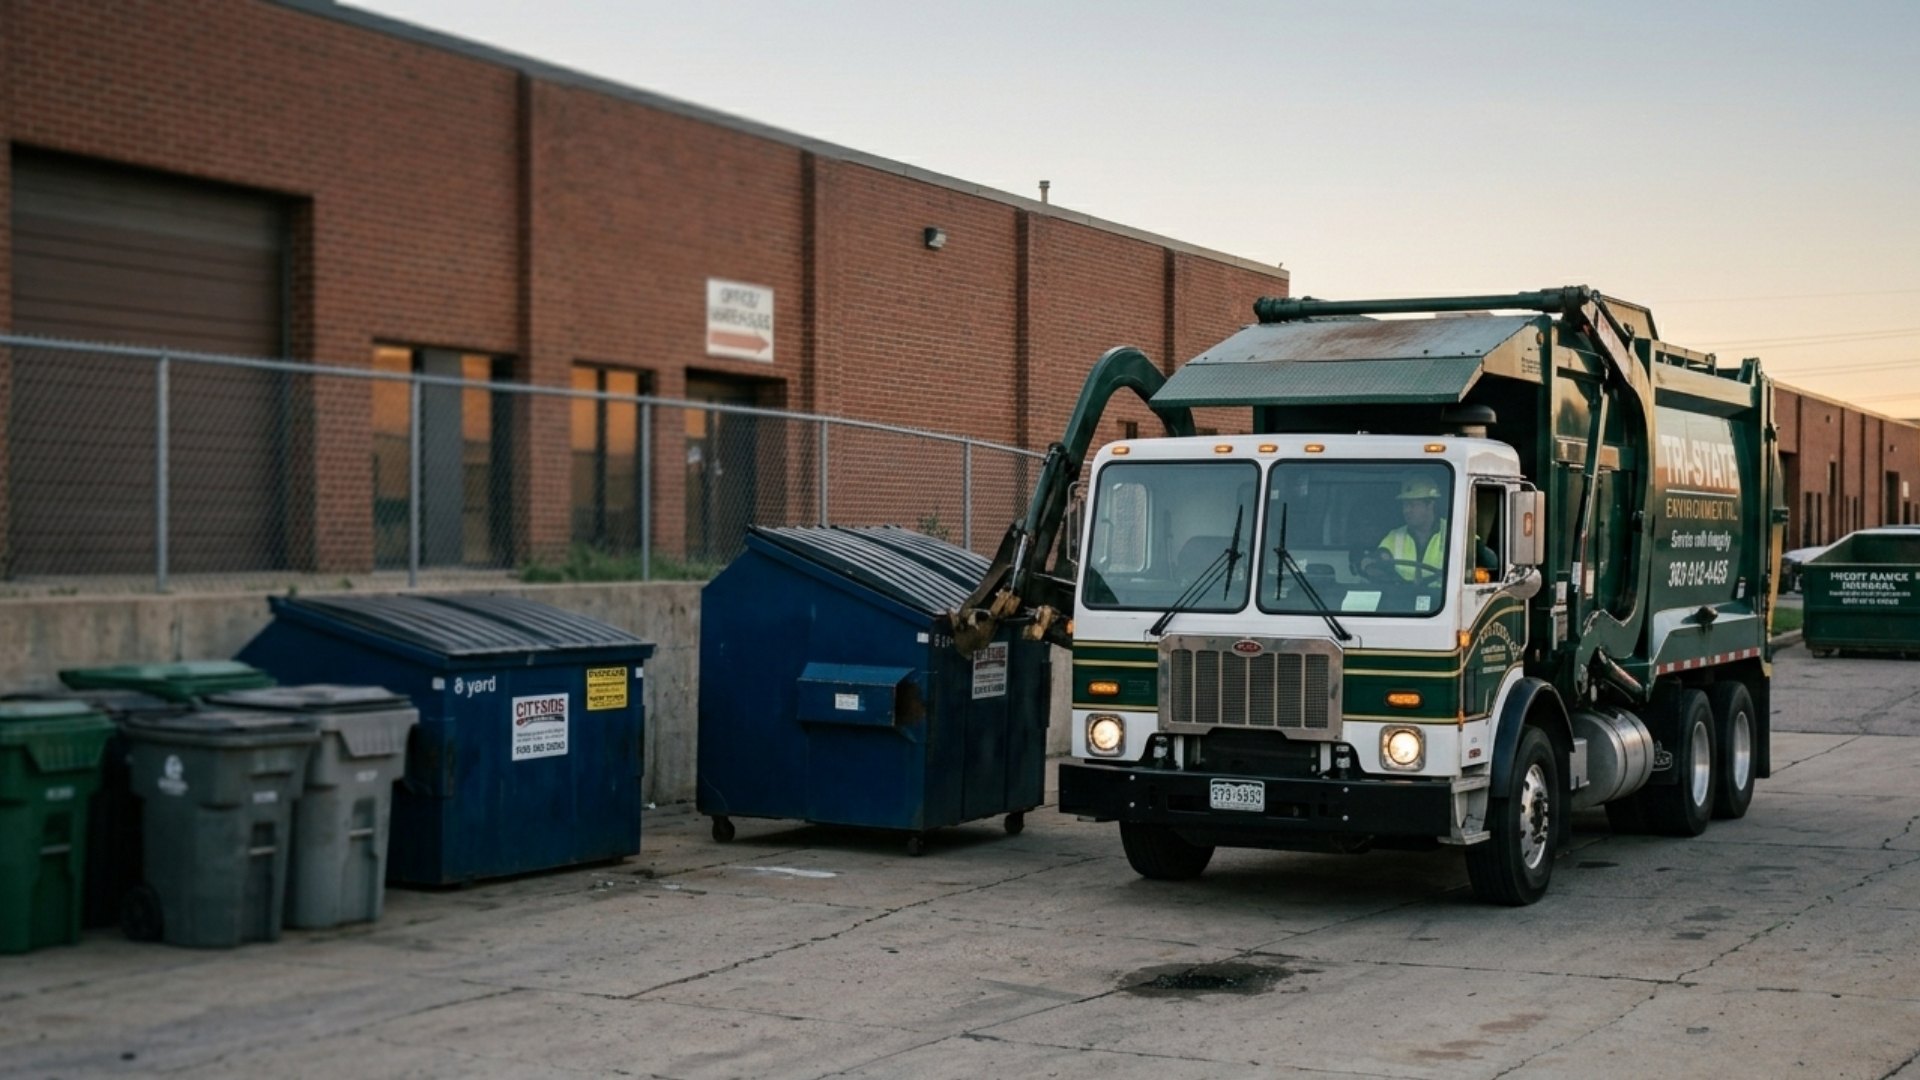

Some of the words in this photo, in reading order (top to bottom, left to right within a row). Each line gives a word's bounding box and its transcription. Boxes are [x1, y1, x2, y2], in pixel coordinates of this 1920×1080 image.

[1661, 435, 1738, 489] TRI-STATE
[454, 676, 464, 694] 8
[467, 675, 497, 698] yard
